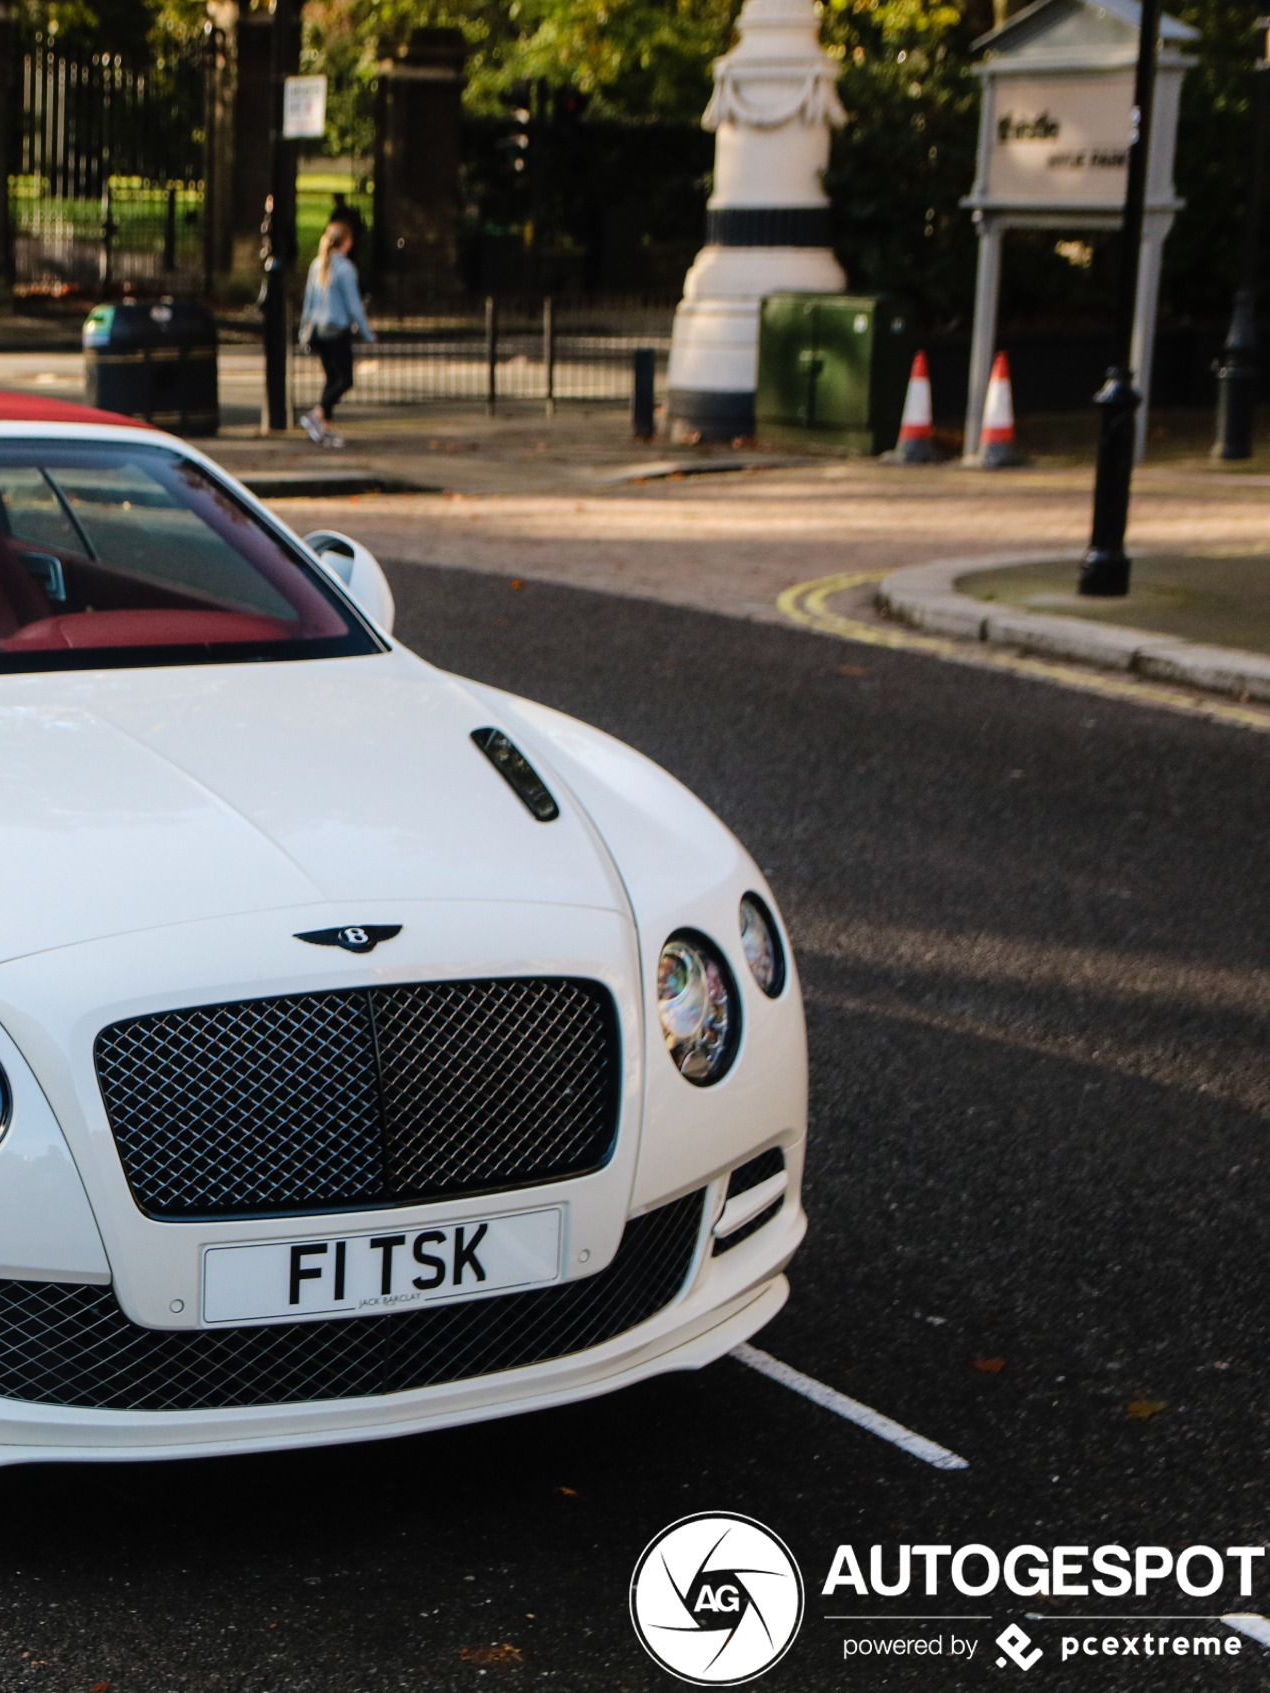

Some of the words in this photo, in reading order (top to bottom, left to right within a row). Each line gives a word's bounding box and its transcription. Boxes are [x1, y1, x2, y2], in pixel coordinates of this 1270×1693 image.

[344, 927, 369, 944] B
[370, 1223, 488, 1296] TSK
[359, 1297, 380, 1309] JACK
[383, 1292, 421, 1304] BARCLAY
